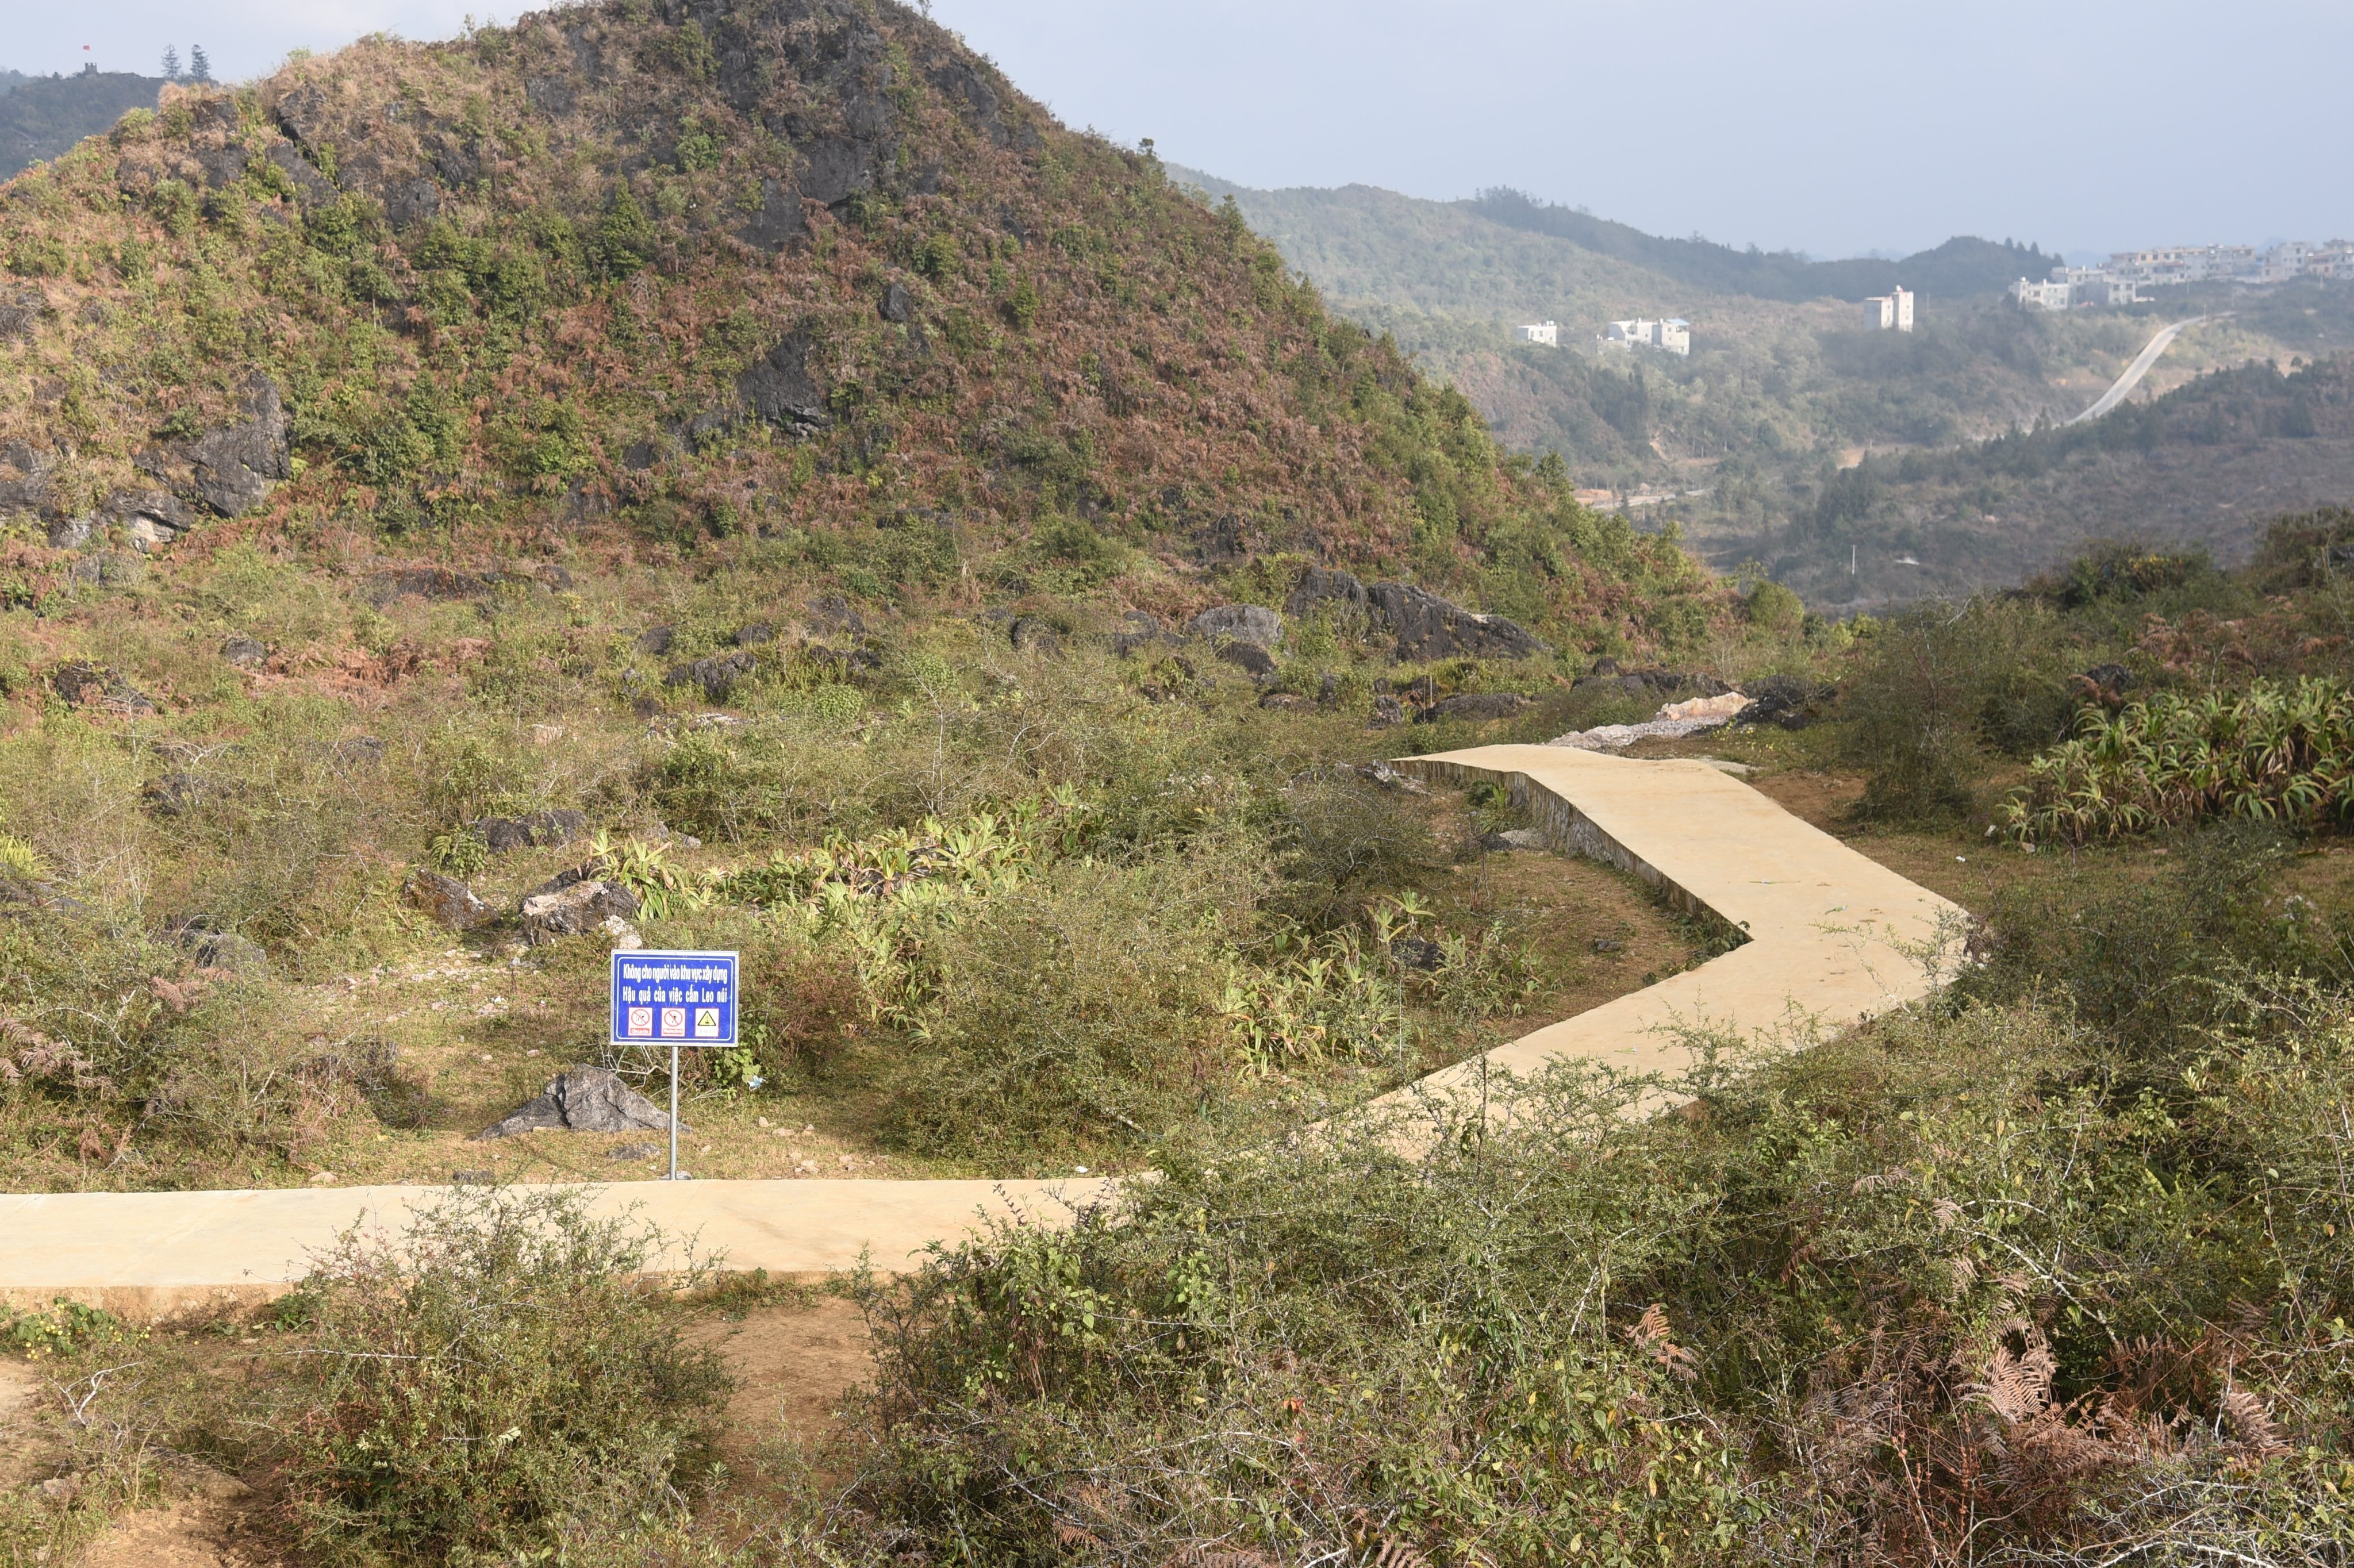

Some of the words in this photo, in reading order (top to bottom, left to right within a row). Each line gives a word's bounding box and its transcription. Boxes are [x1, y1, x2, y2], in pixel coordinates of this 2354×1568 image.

[623, 963, 641, 983] Không
[642, 964, 652, 979] cho
[652, 964, 669, 983] người
[670, 964, 680, 980] vào
[681, 964, 690, 980] khu
[691, 968, 702, 983] vực
[702, 964, 713, 984] xây
[713, 965, 728, 985] dựng
[623, 986, 636, 1004] Hậu
[639, 986, 651, 1005] quả
[654, 986, 666, 1002] của
[669, 986, 682, 1005] việc
[685, 983, 698, 1003] cấm
[702, 987, 714, 1003] Leo
[717, 987, 727, 1003] núi
